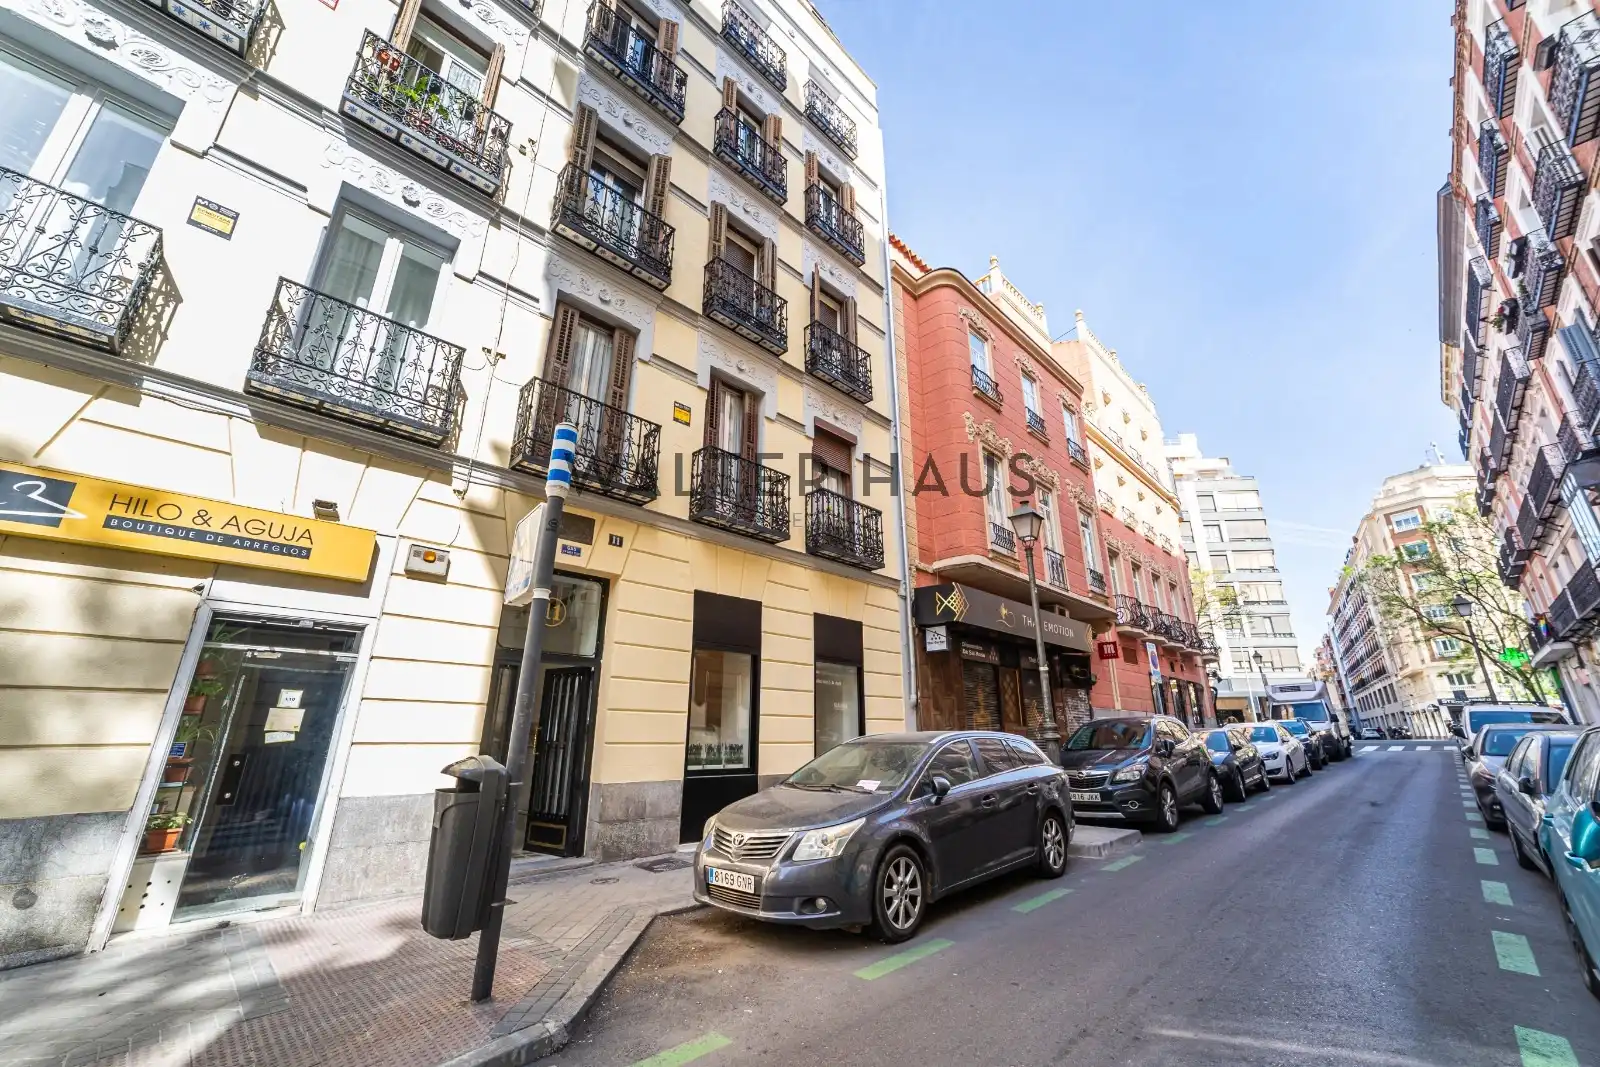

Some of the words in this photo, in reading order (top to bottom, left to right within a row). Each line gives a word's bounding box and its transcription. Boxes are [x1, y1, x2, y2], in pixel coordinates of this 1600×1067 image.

[108, 493, 182, 521] HILO
[192, 509, 212, 528] &
[220, 515, 314, 545] AGUJA
[110, 518, 197, 539] BOUTIQUE
[206, 533, 224, 543] DE
[232, 539, 308, 556] ARREGLOS
[1043, 621, 1075, 638] EMOTION
[714, 870, 735, 886] 8169
[736, 875, 753, 891] GNR
